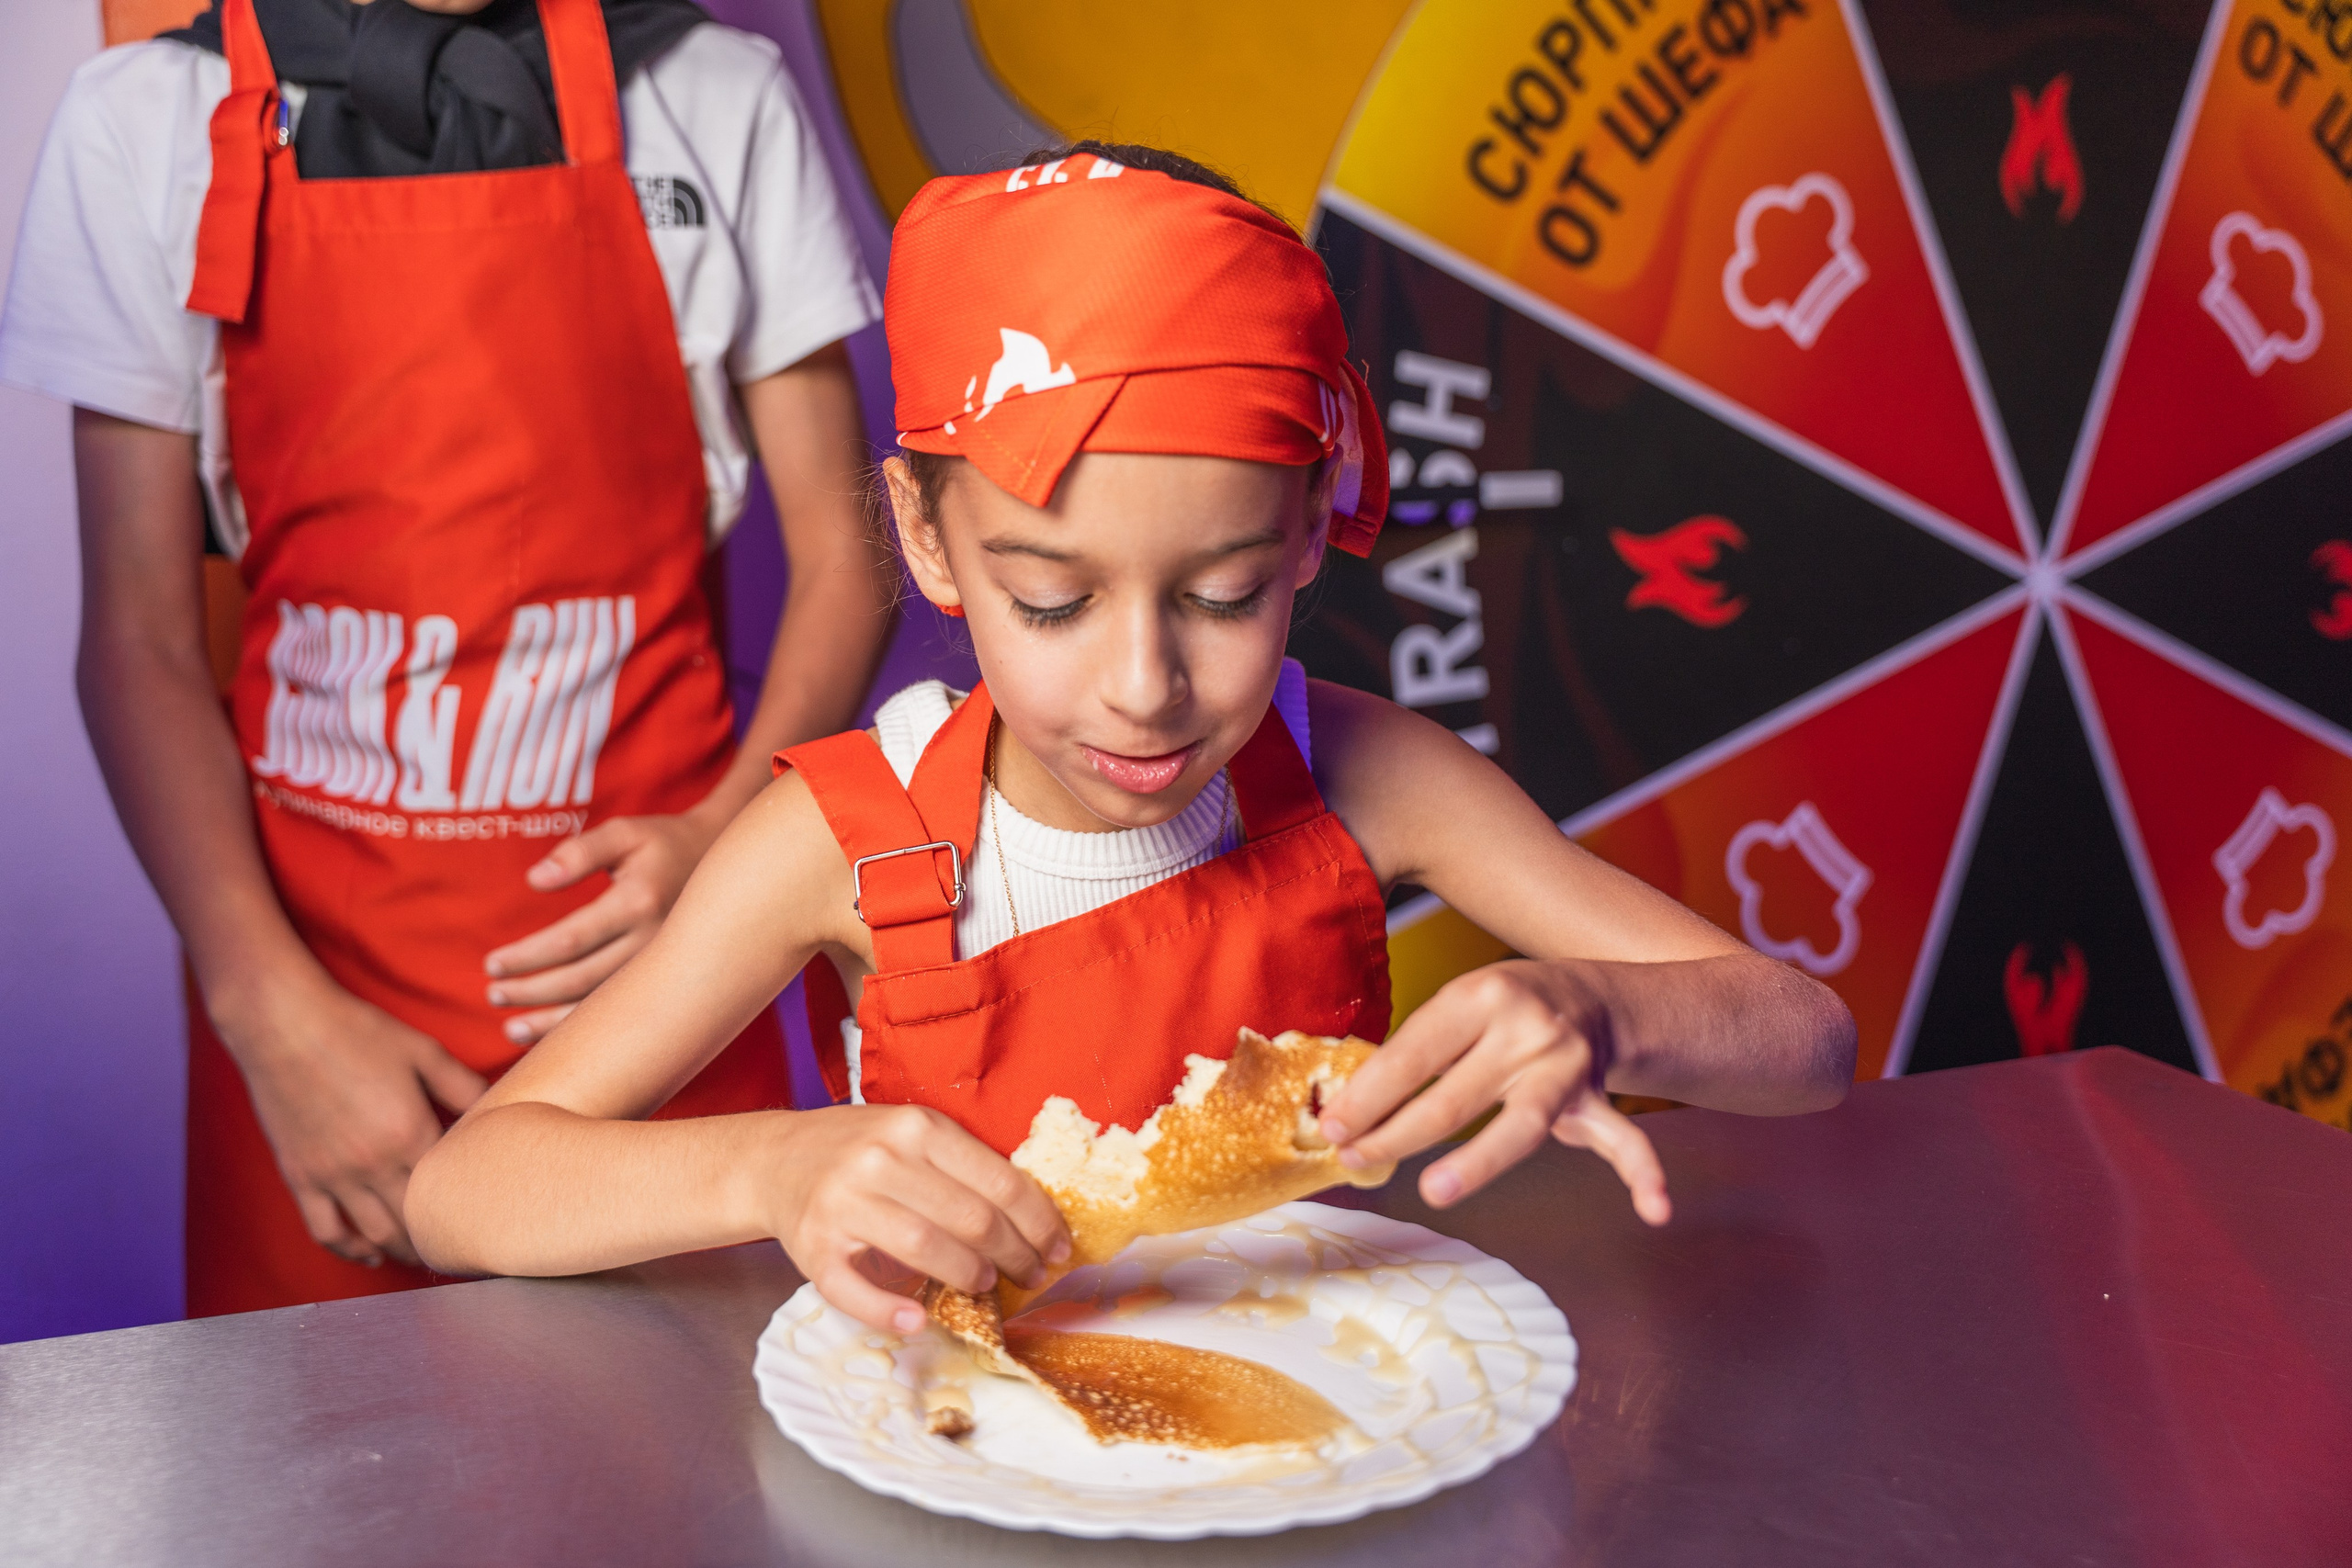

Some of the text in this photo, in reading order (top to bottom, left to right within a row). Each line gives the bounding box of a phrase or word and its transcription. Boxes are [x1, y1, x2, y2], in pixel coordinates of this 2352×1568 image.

[2238, 16, 2322, 110] ОТ
[1537, 147, 1623, 269] ОТ
[459, 594, 636, 811] RUN
